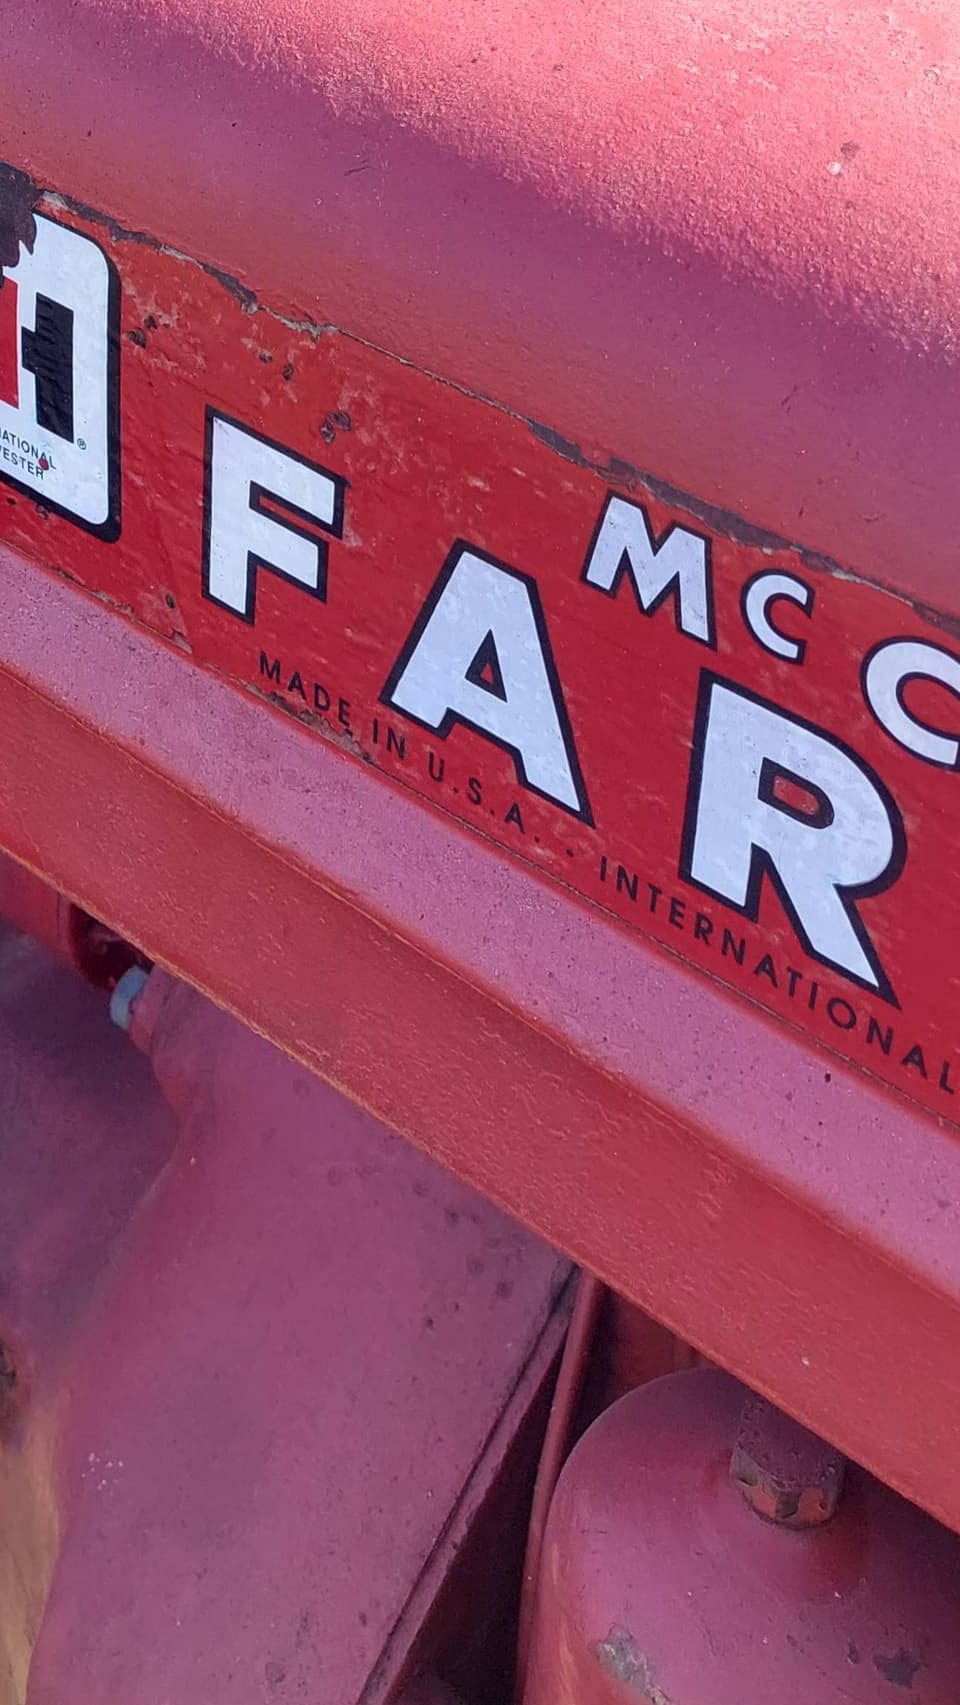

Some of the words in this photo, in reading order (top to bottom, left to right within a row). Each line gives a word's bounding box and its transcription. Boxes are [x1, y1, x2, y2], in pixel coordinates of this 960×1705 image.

[202, 405, 909, 1011] FAR
[259, 650, 351, 728] MADE
[371, 718, 406, 761] IN
[427, 751, 540, 843] U.S.A.
[599, 855, 955, 1095] INTERNATIONAL
